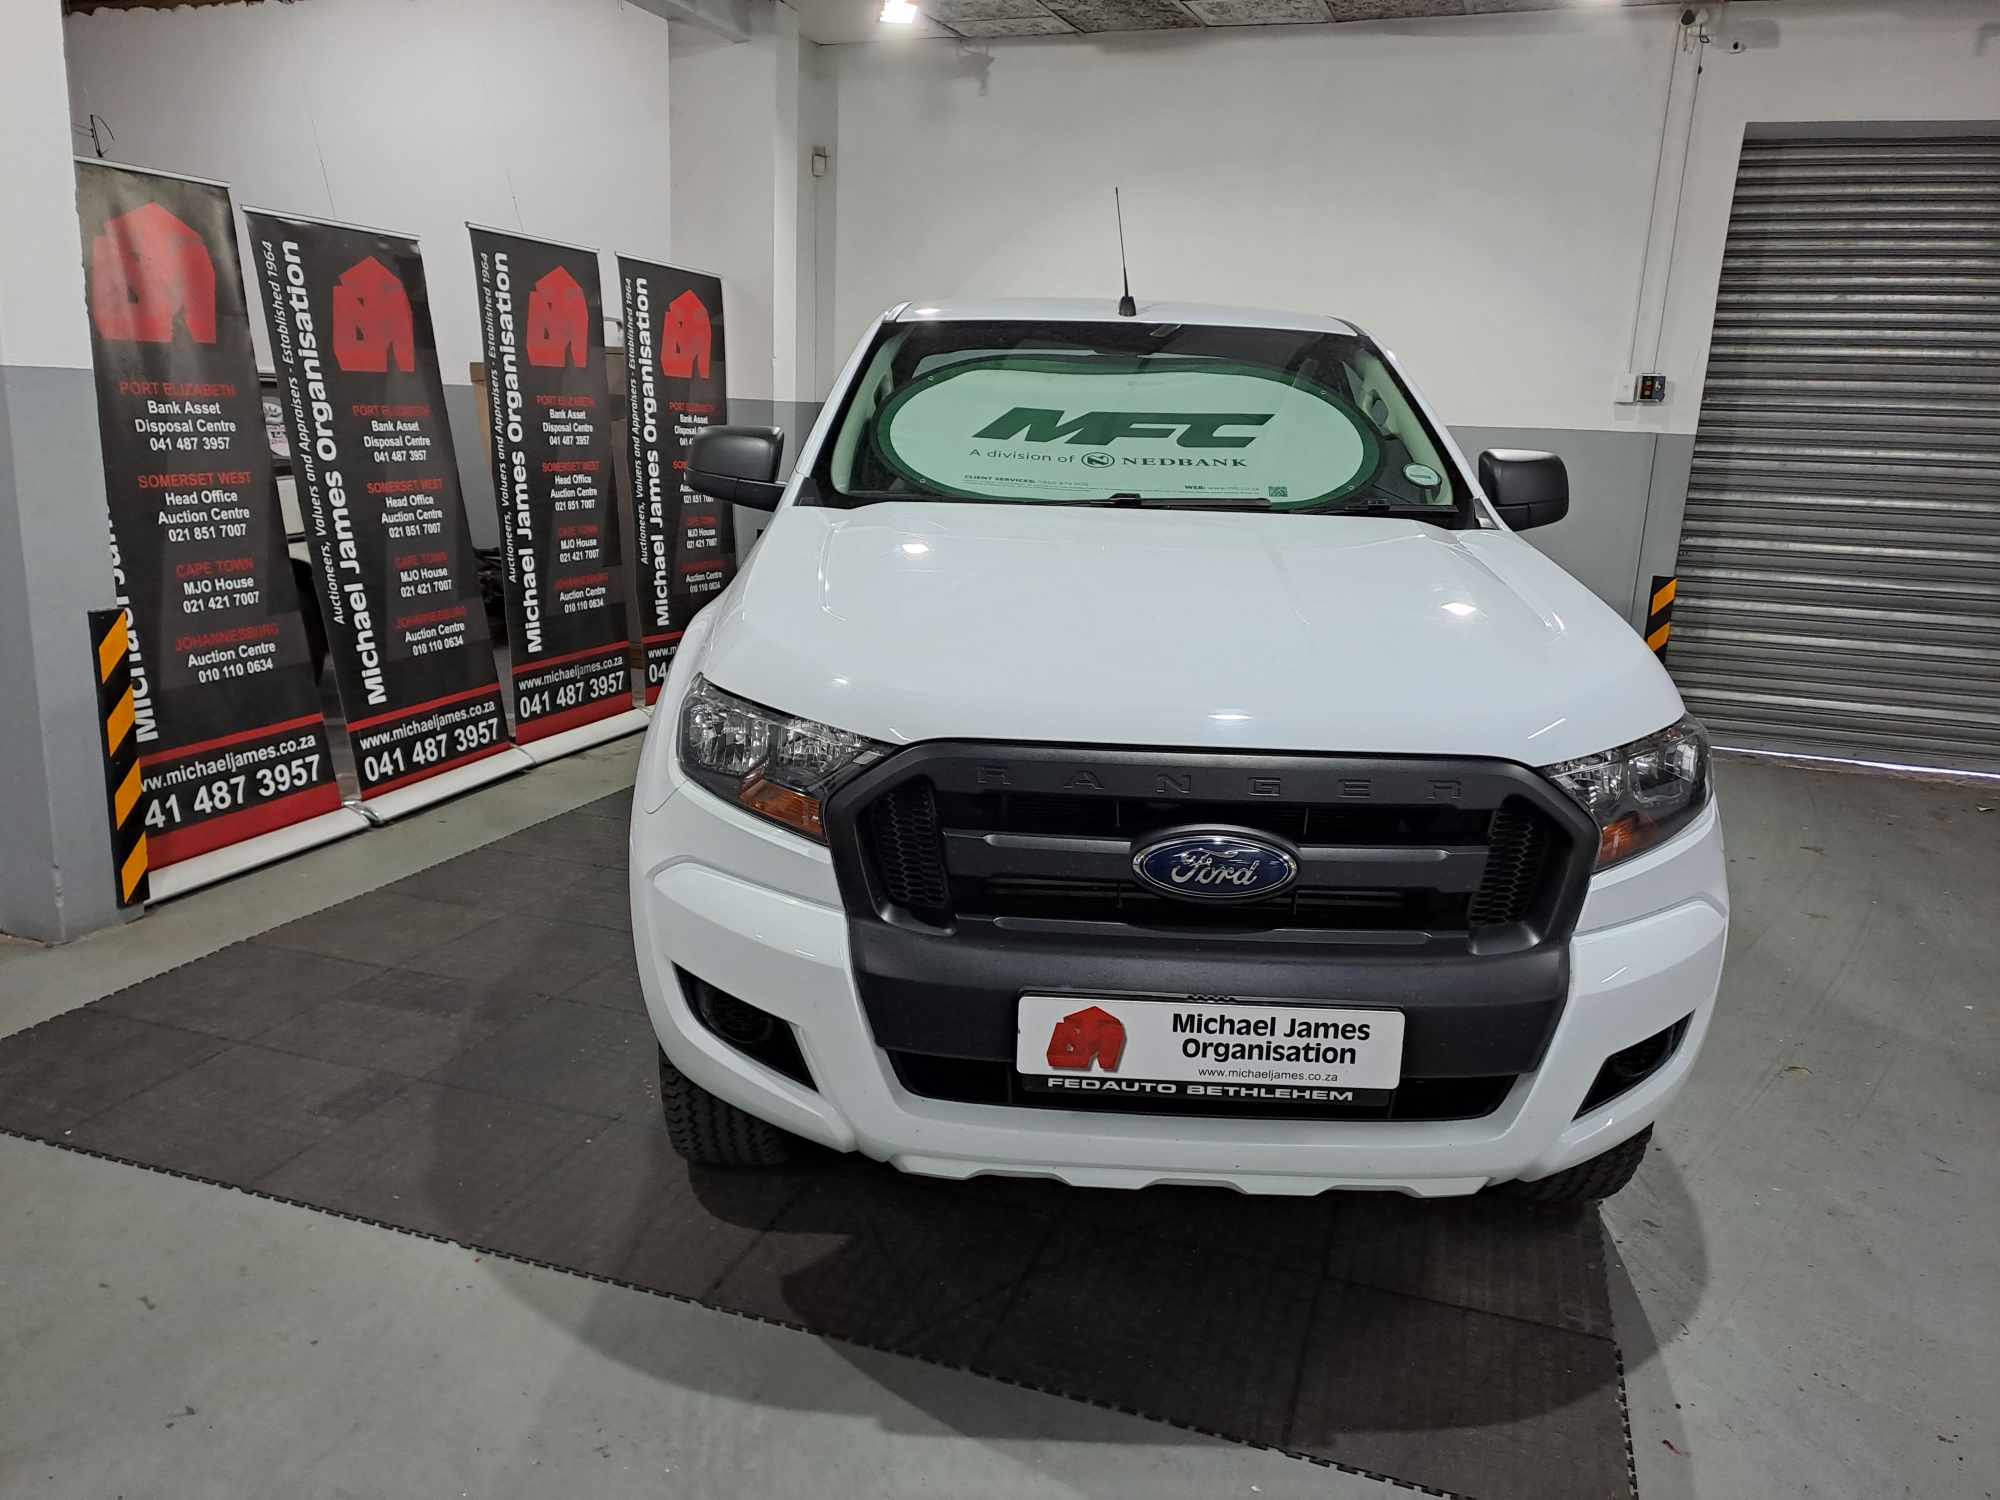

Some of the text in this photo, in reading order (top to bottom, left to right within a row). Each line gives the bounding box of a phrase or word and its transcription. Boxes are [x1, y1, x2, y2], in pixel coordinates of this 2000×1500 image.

[636, 277, 657, 444] Organisation
[120, 381, 159, 394] PORT
[147, 400, 221, 414] Bank Asset
[549, 409, 566, 419] Bank
[135, 419, 236, 435] Disposal Centre
[371, 420, 420, 431] Bank Asset
[480, 252, 517, 584] Auctioneers, Valuers and Appraisers Established 1964
[542, 422, 593, 433] Disposal Centre
[262, 240, 345, 624] Auctioneers, Valuers and Appraisers Established 1964
[971, 407, 1277, 449] MFC
[150, 437, 230, 451] 041 487 3957
[363, 435, 431, 449] Disposal Centre
[374, 450, 426, 462] 041 487 3957
[495, 252, 543, 654] Michael James Organisation
[969, 448, 1248, 467] A division of NEDBANK
[137, 471, 251, 488] SOMERSET WEST
[282, 240, 387, 705] Michael James Organisation
[554, 474, 592, 485] Head Office
[165, 490, 238, 506] Head Office
[550, 487, 598, 498] Auction Centre
[647, 450, 663, 527] James
[385, 494, 434, 508] Head Office
[158, 507, 250, 525] Auction Centre
[381, 509, 442, 523] Auction Centre
[168, 523, 247, 542] 021 851 7007
[389, 523, 441, 538] 021 851 7007
[400, 567, 448, 582] MJO House
[651, 533, 670, 627] Michael
[183, 577, 254, 595] MJO House
[400, 580, 452, 598] 021 421 7007
[560, 590, 584, 601] Auction
[183, 591, 260, 614] 021 421 7007
[405, 622, 465, 642] Auction Centre
[188, 642, 276, 668] Auction Centre
[412, 635, 464, 656] 010 110 0634
[198, 658, 274, 683] 010 110 0634
[518, 655, 623, 692] www.michaeljames.co.za
[519, 671, 624, 719] 041 487 3957
[360, 701, 495, 750] www.michaeljames.co.za
[364, 717, 499, 782] 041 487 3957
[141, 734, 316, 792] ww.michaeljames.co.za
[144, 753, 321, 829] 41 487 3957
[976, 766, 1463, 799] RANGER
[1171, 846, 1258, 888] Ford
[1172, 1013, 1371, 1041] Michael James
[1181, 1038, 1356, 1064] Organisation
[1198, 1067, 1338, 1083] www.michaeljames.co.za
[1048, 1077, 1353, 1102] FEDAUTO BETHLEHEM
